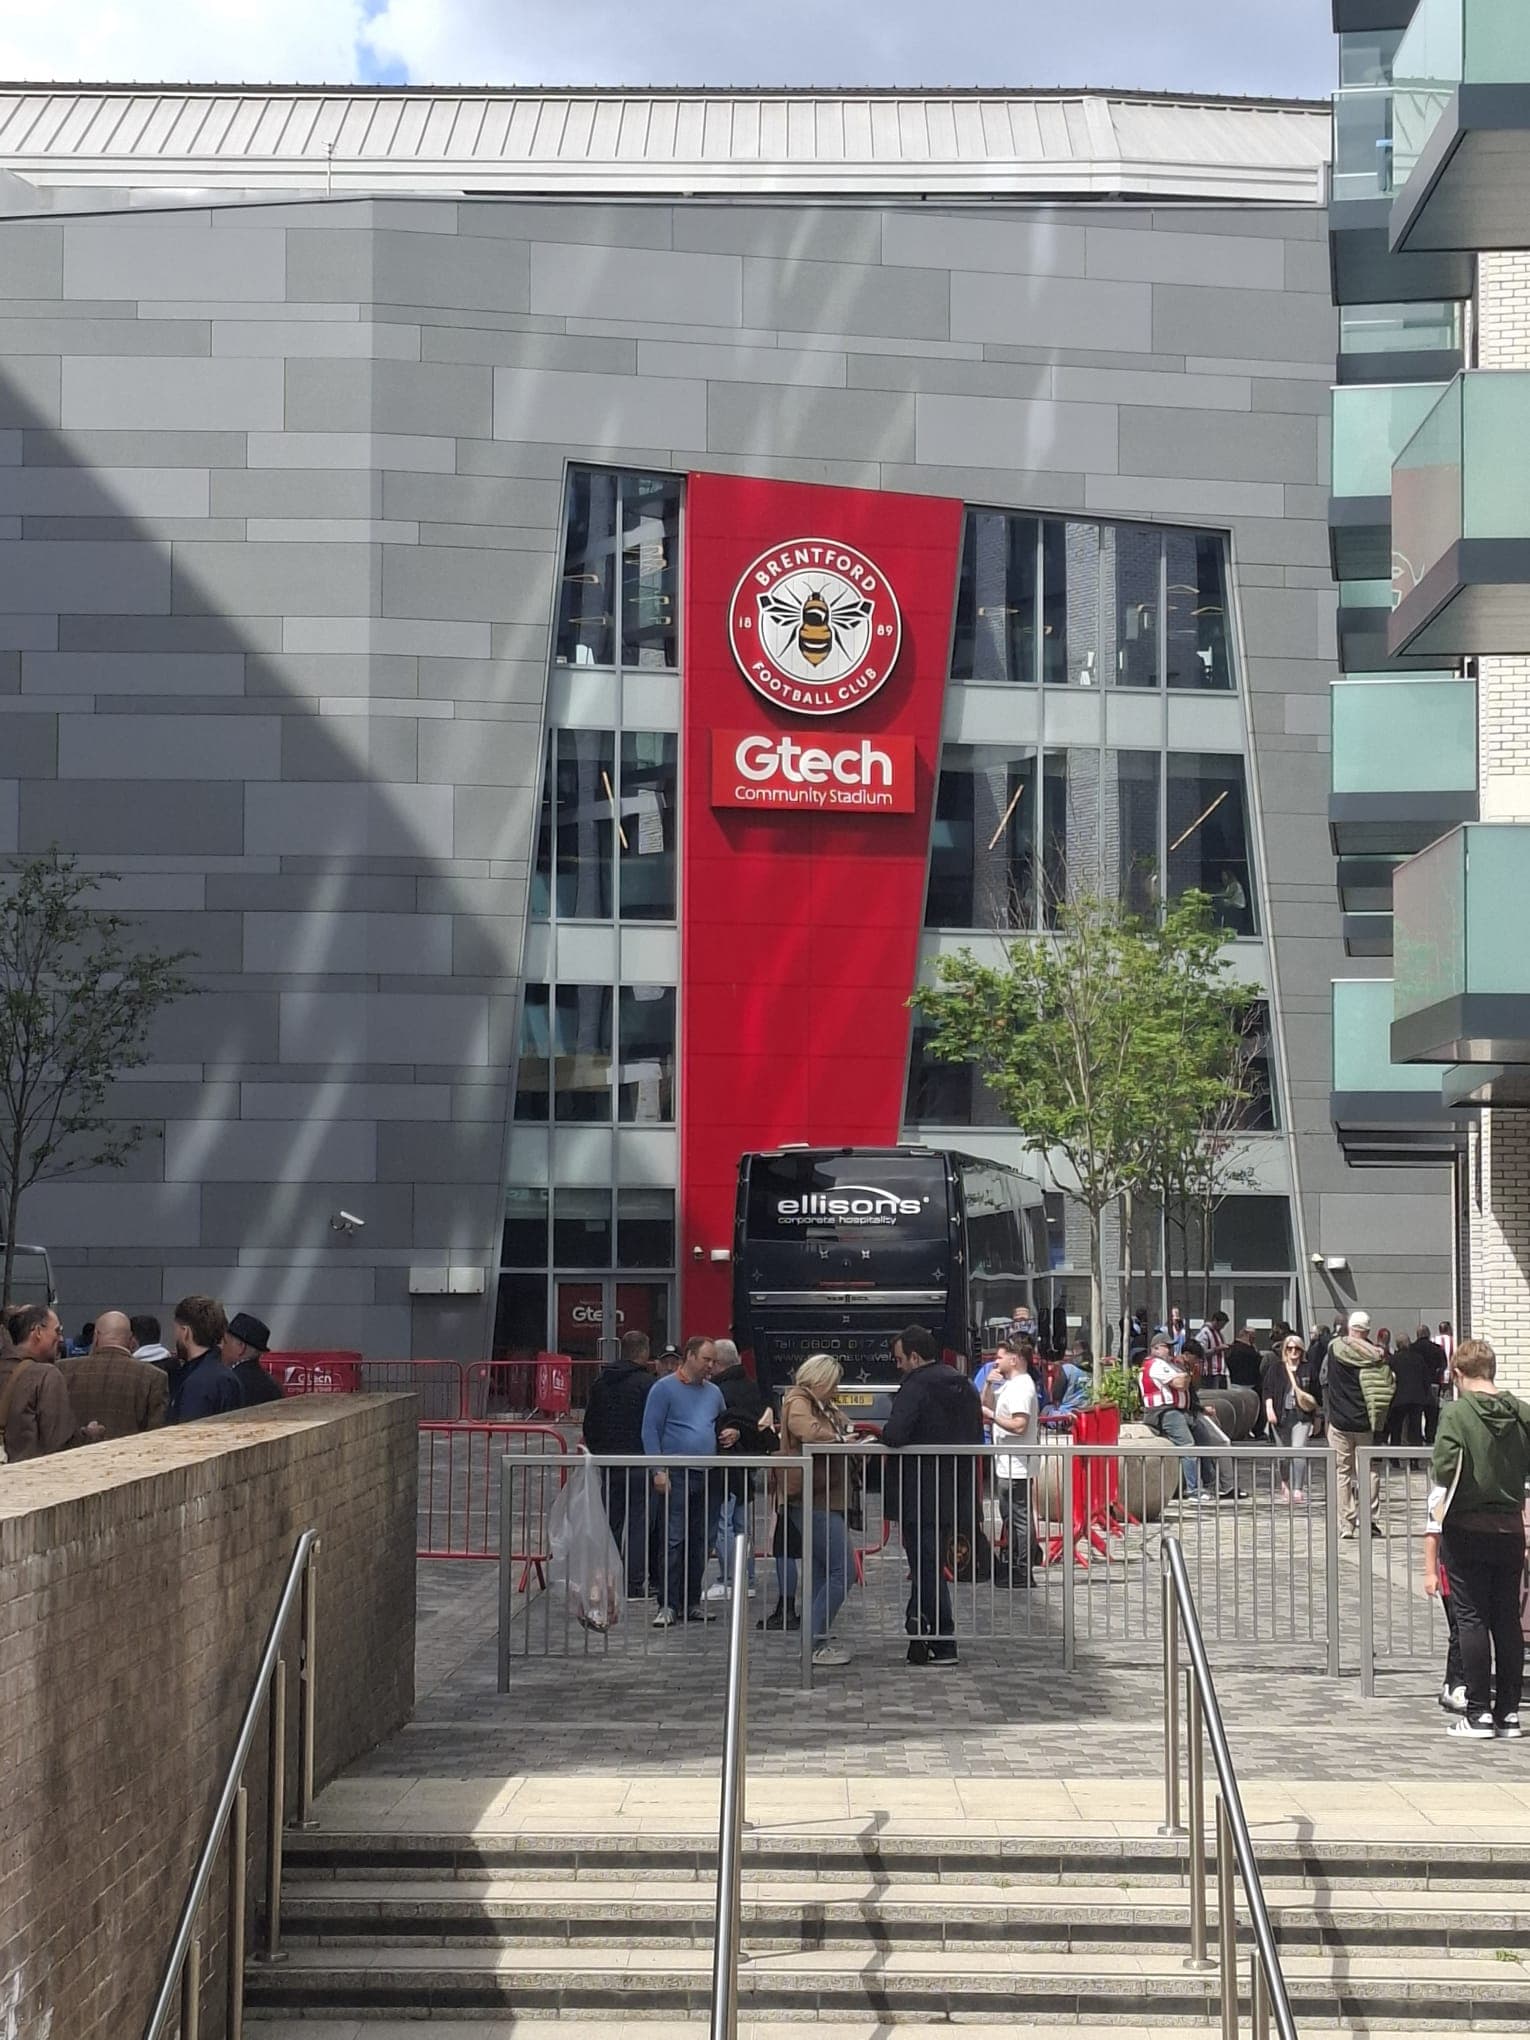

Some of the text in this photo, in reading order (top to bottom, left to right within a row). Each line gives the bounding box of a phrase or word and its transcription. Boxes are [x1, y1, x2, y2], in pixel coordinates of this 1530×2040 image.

[755, 548, 877, 591] BRENTFORD
[738, 616, 752, 629] 18
[876, 625, 893, 637] 89
[752, 661, 878, 705] FOOTBALL CLUB
[735, 735, 893, 786] Gtech
[735, 786, 893, 806] Community Stadium
[777, 1194, 921, 1215] ellisons
[777, 1215, 897, 1225] corporate hospitality
